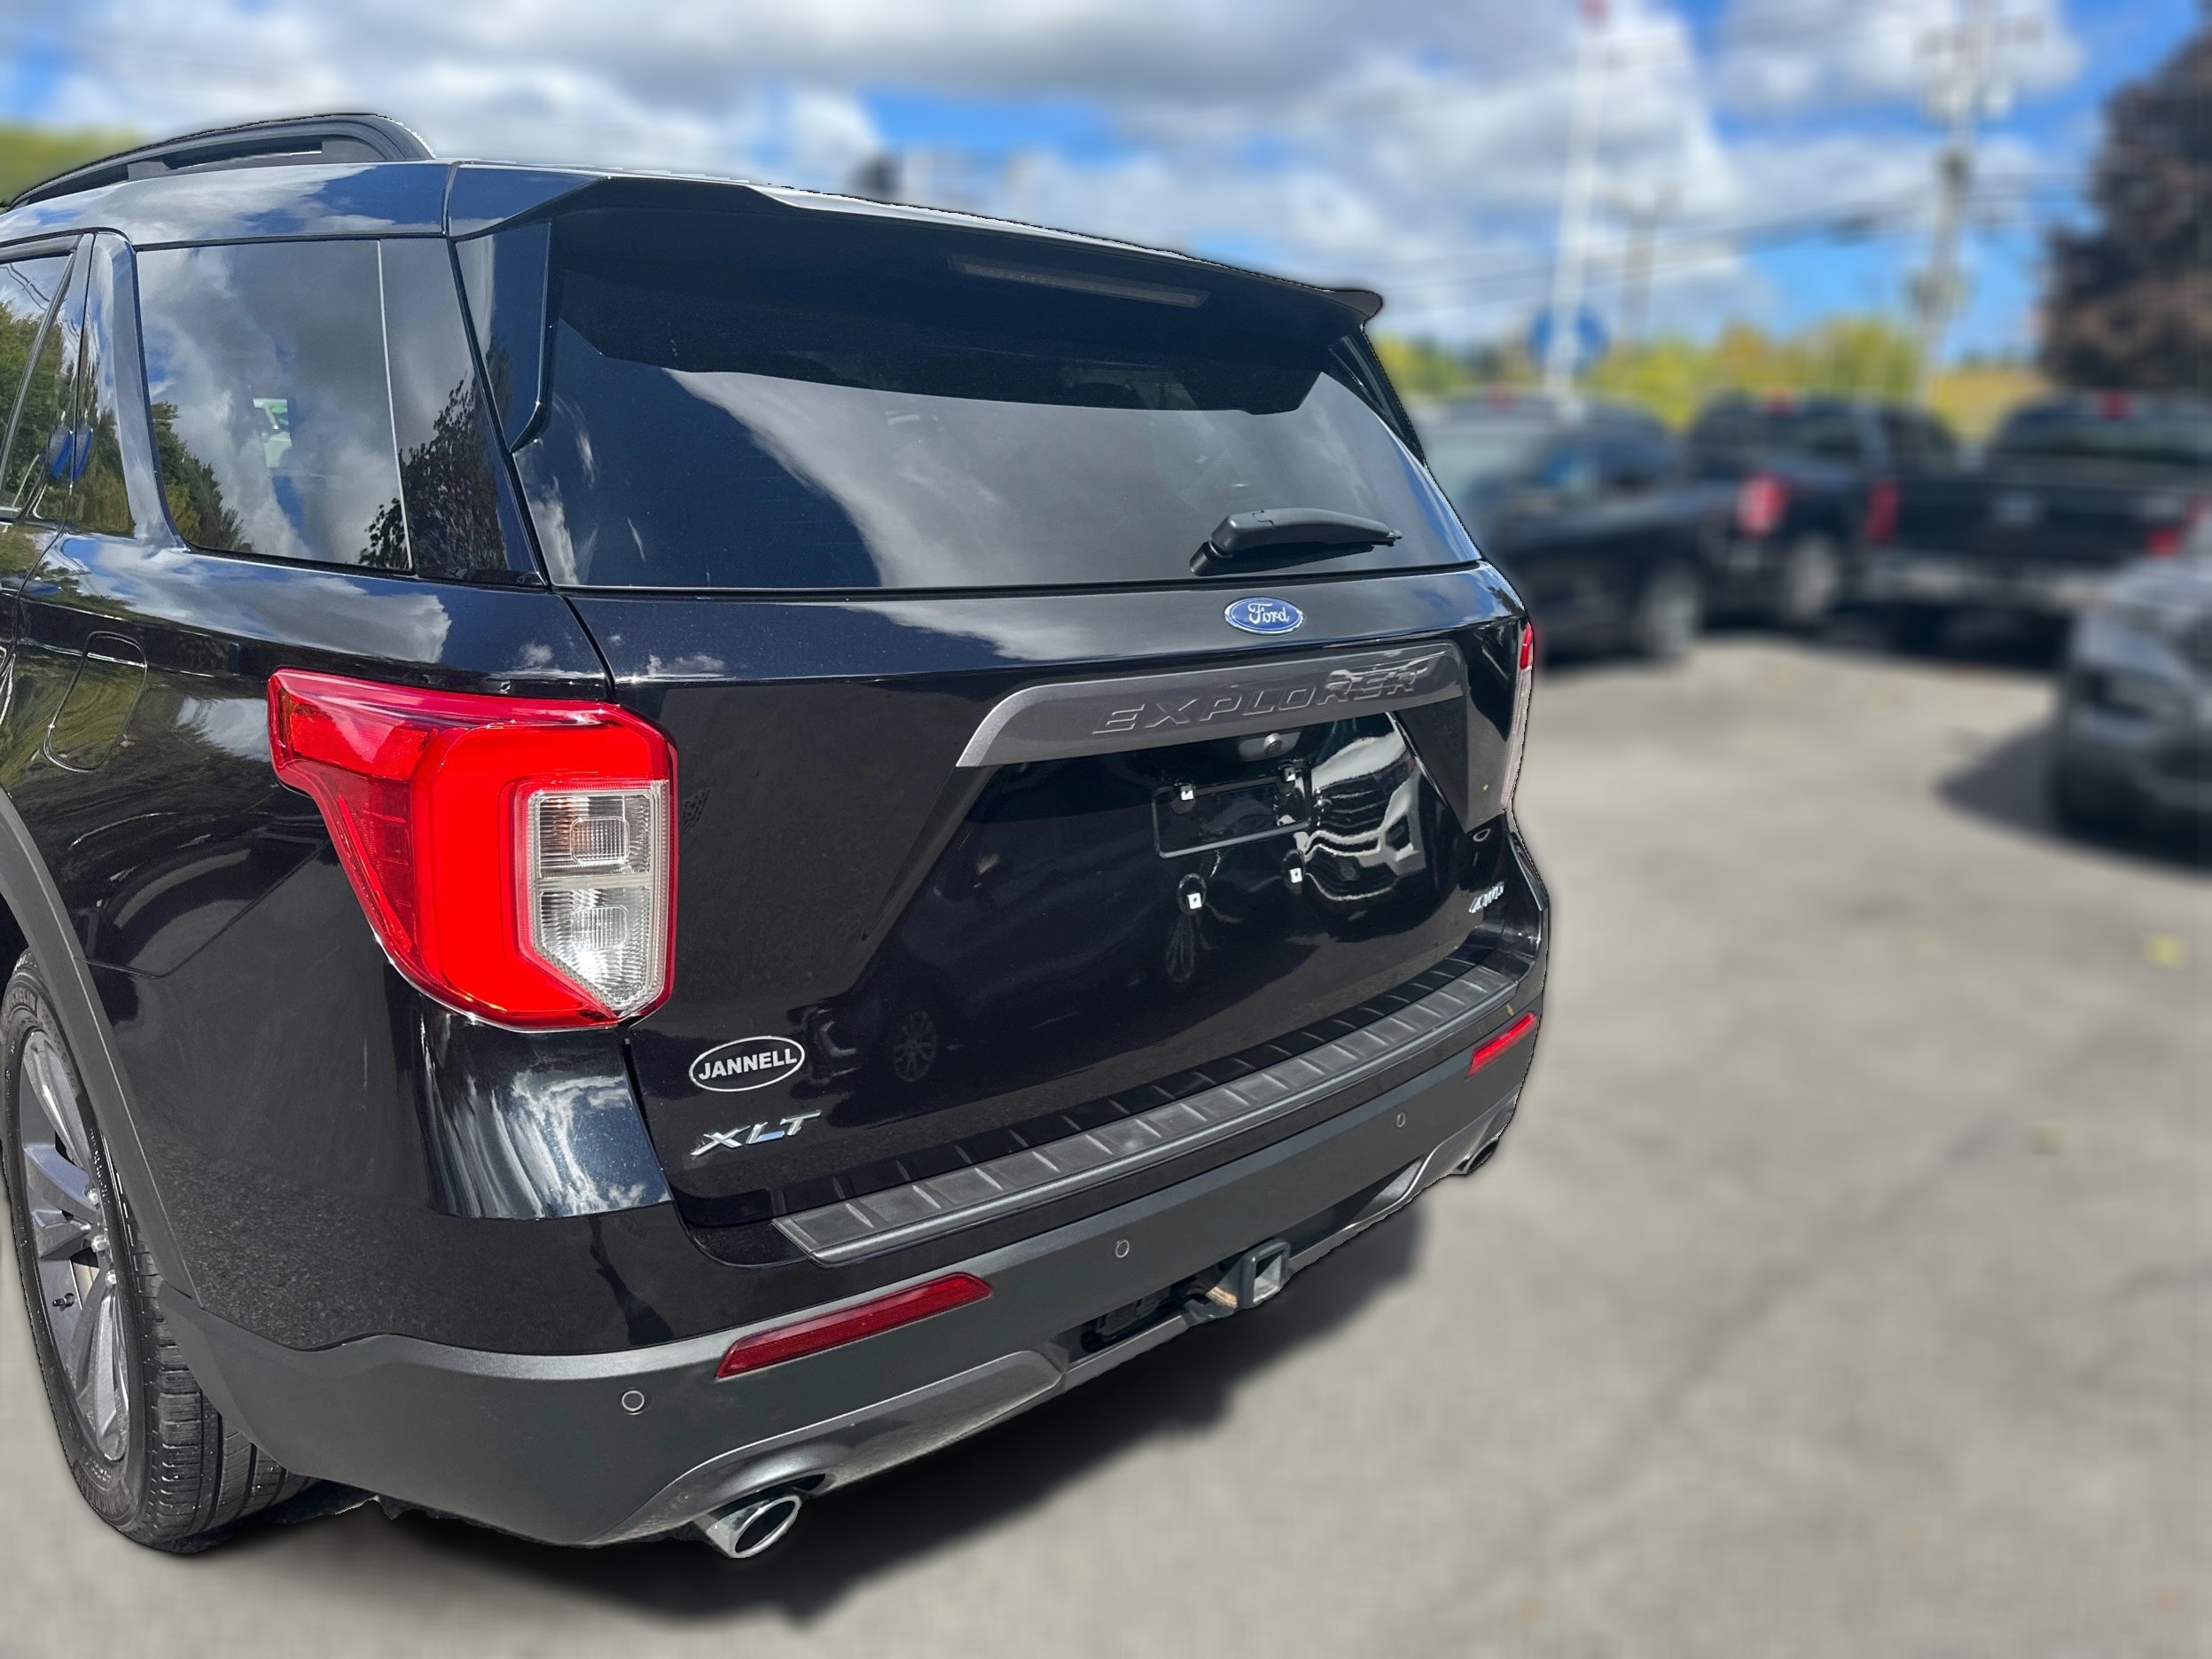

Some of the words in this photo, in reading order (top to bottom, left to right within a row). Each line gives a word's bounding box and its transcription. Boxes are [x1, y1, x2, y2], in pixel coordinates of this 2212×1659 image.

[1247, 603, 1289, 624] Ford
[1092, 668, 1420, 734] EXPLORER
[698, 1048, 797, 1080] JANNELL
[690, 1110, 822, 1156] XLT
